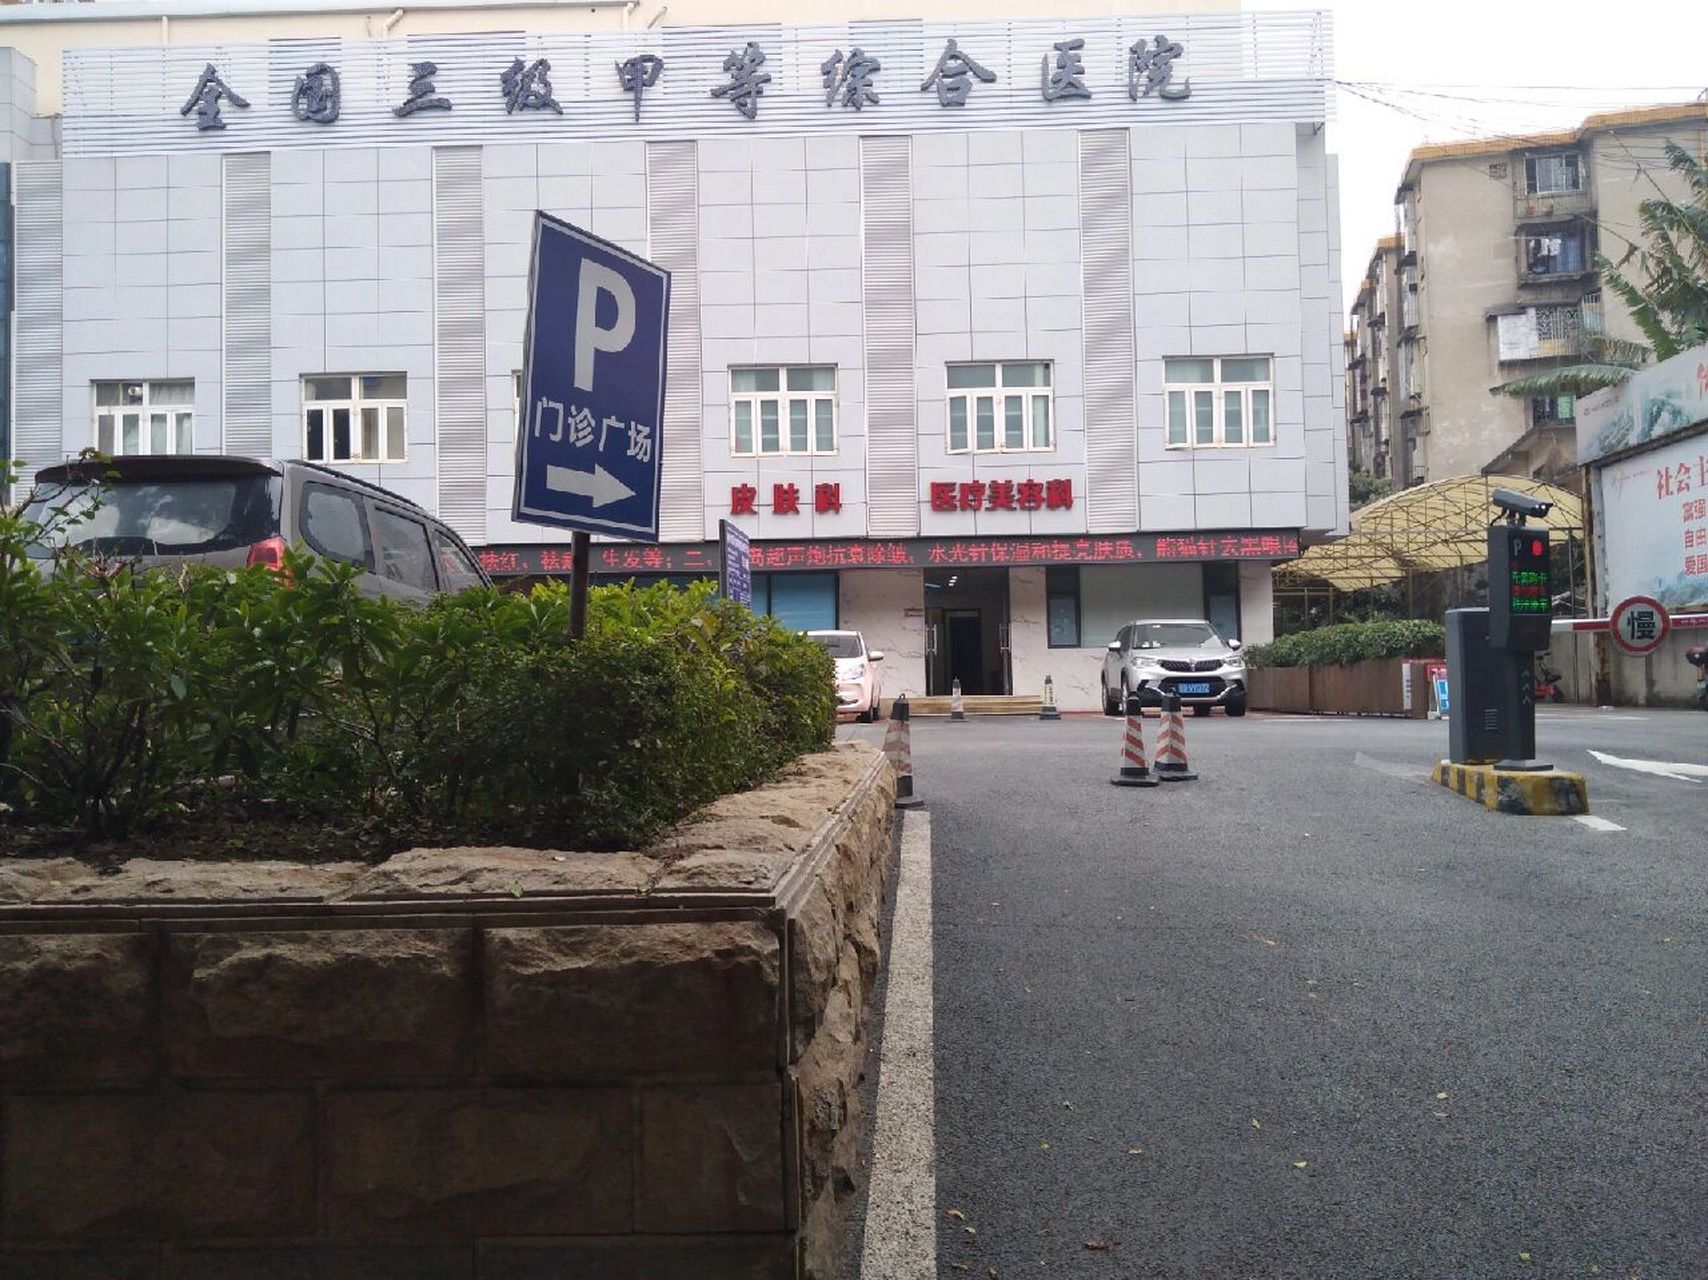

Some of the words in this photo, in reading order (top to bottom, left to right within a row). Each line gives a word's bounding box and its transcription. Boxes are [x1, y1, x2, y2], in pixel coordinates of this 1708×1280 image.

[574, 257, 636, 392] P
[534, 396, 652, 463] 门诊广场
[730, 483, 842, 515] 皮肤科
[930, 478, 1073, 512] 医疗美容科
[1683, 498, 1706, 523] 富强
[1685, 553, 1708, 576] 爱国
[1627, 611, 1656, 640] 慢
